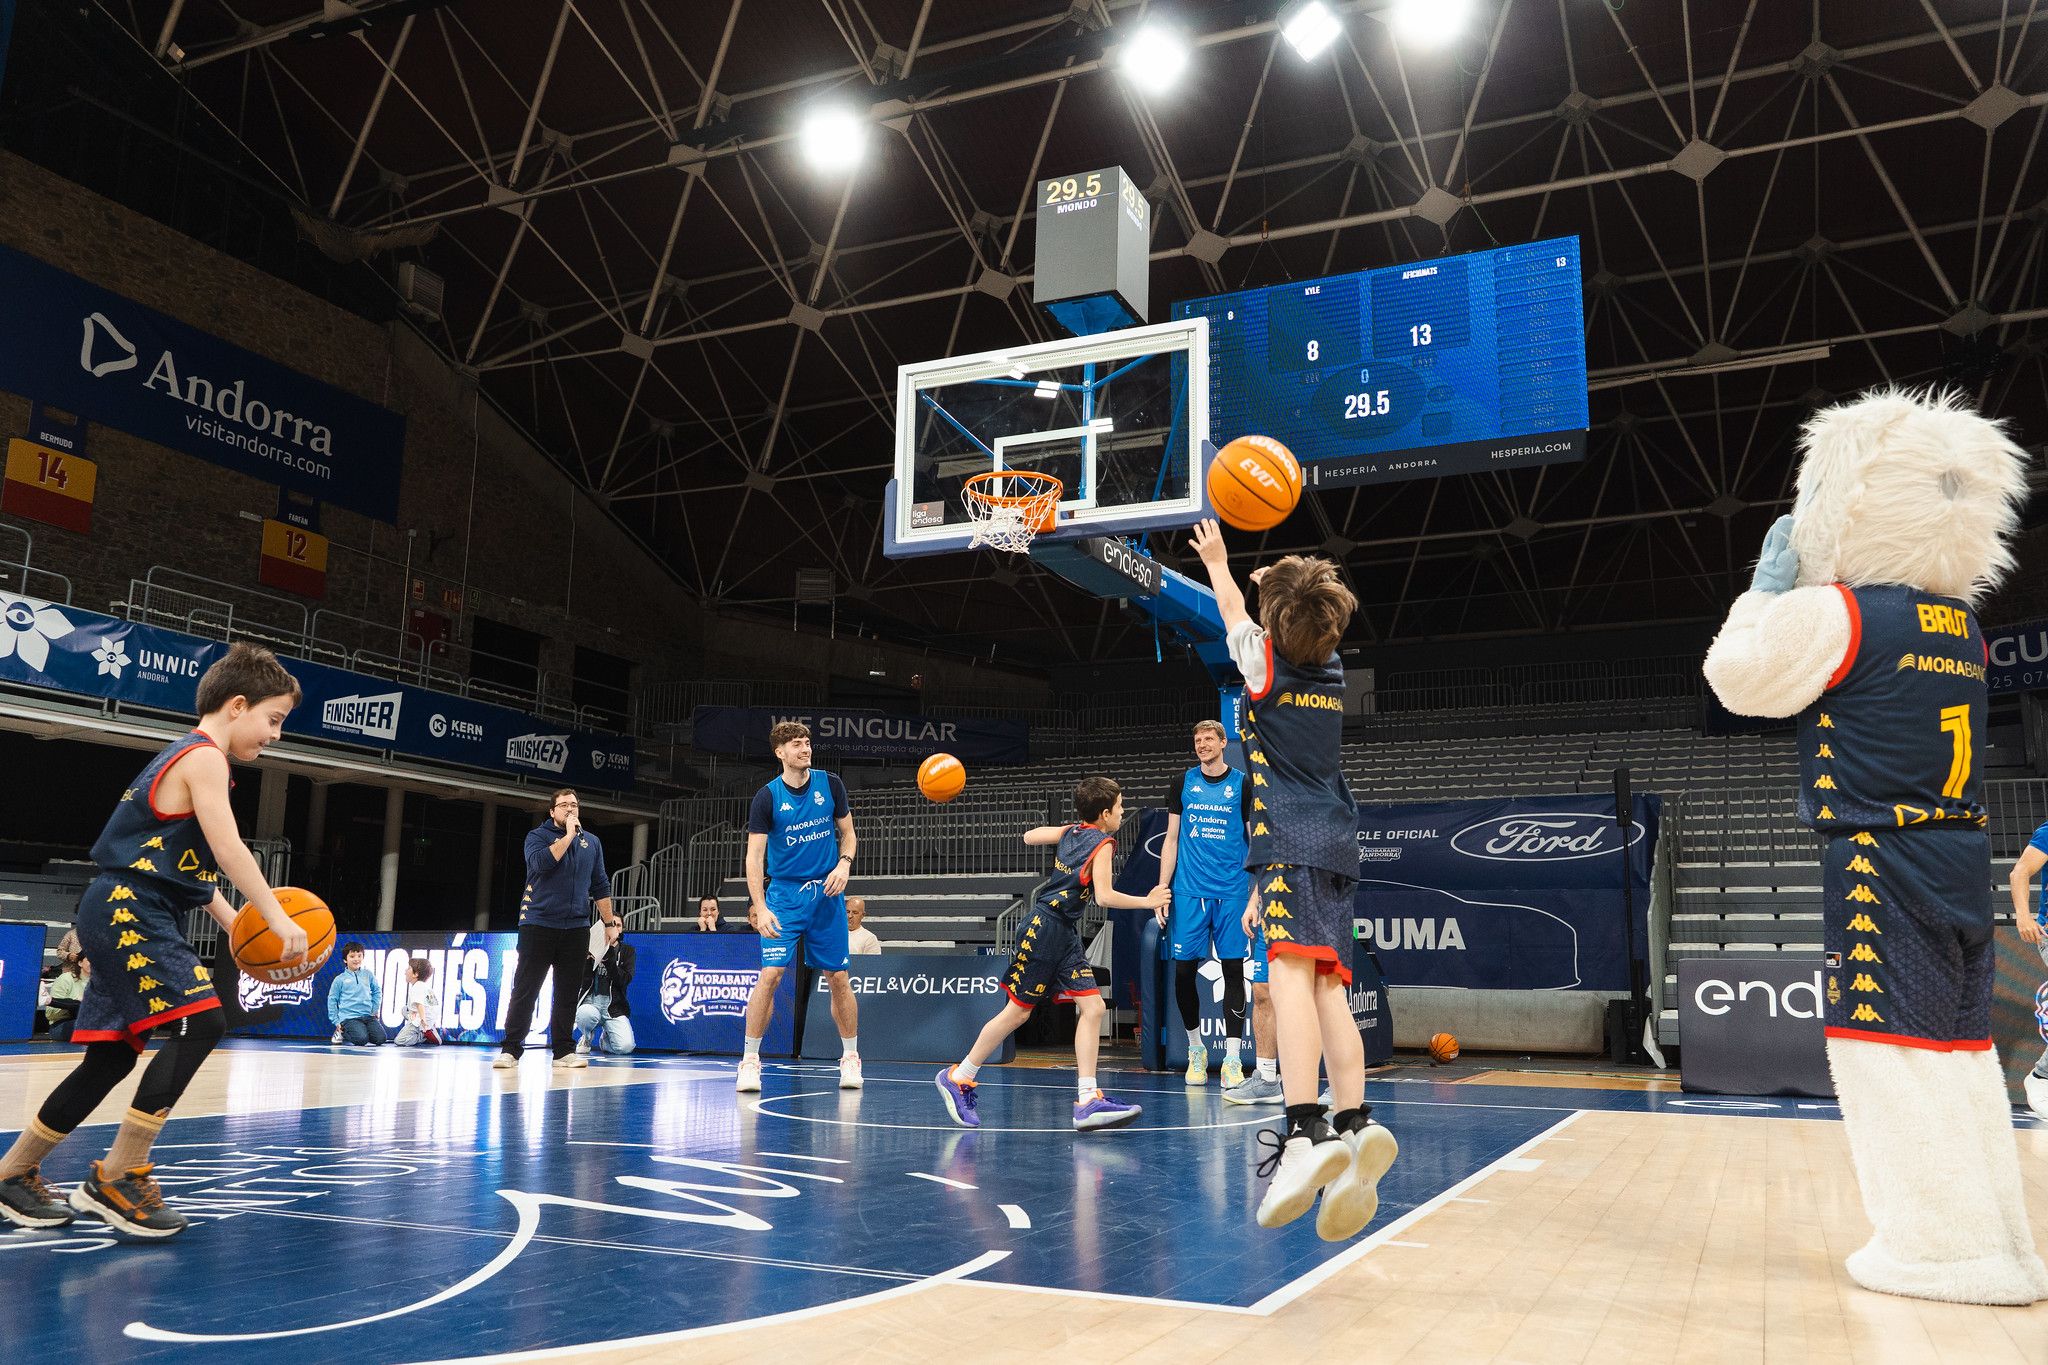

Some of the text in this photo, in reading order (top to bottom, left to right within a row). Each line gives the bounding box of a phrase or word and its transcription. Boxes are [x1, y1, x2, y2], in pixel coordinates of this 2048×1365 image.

[1046, 173, 1101, 204] 29.5
[1123, 178, 1144, 220] 29.5
[1057, 198, 1097, 214] MONDO
[1555, 256, 1566, 267] 13
[1304, 286, 1320, 296] KYLE
[1228, 311, 1234, 320] 8
[1410, 323, 1432, 347] 13
[1307, 340, 1319, 361] 8
[1361, 369, 1369, 383] 0
[143, 350, 333, 457] Andorra
[1344, 390, 1390, 419] 29.5
[40, 431, 73, 449] BERMUDO
[185, 414, 331, 480] visitandorra.com
[1491, 442, 1572, 459] HESPERIA.COM
[38, 451, 68, 490] 14
[1325, 458, 1438, 478] HESPERIA ANDORRA
[912, 509, 927, 519] liga
[286, 530, 308, 563] 12
[1103, 542, 1152, 588] endesa
[1916, 603, 1969, 640] BRUT
[1989, 631, 2048, 667] GU
[138, 649, 200, 678] UNNIC
[136, 671, 170, 684] ANDORRA
[2023, 671, 2048, 685] 07
[325, 701, 395, 730] FINISHER
[451, 720, 483, 736] KERN
[819, 716, 957, 742] SINGULAR
[508, 740, 565, 765] FINISHER
[1193, 803, 1233, 814] MORABANC
[1197, 815, 1228, 825] Andorra
[1356, 829, 1439, 840] CLE OFICIAL
[1486, 820, 1606, 854] Ford
[1354, 917, 1467, 951] PUMA
[267, 945, 332, 981] Wilson
[694, 974, 759, 986] MORABANC
[817, 974, 999, 994] EGEL&VÖLKERS
[1694, 971, 1823, 1020] end
